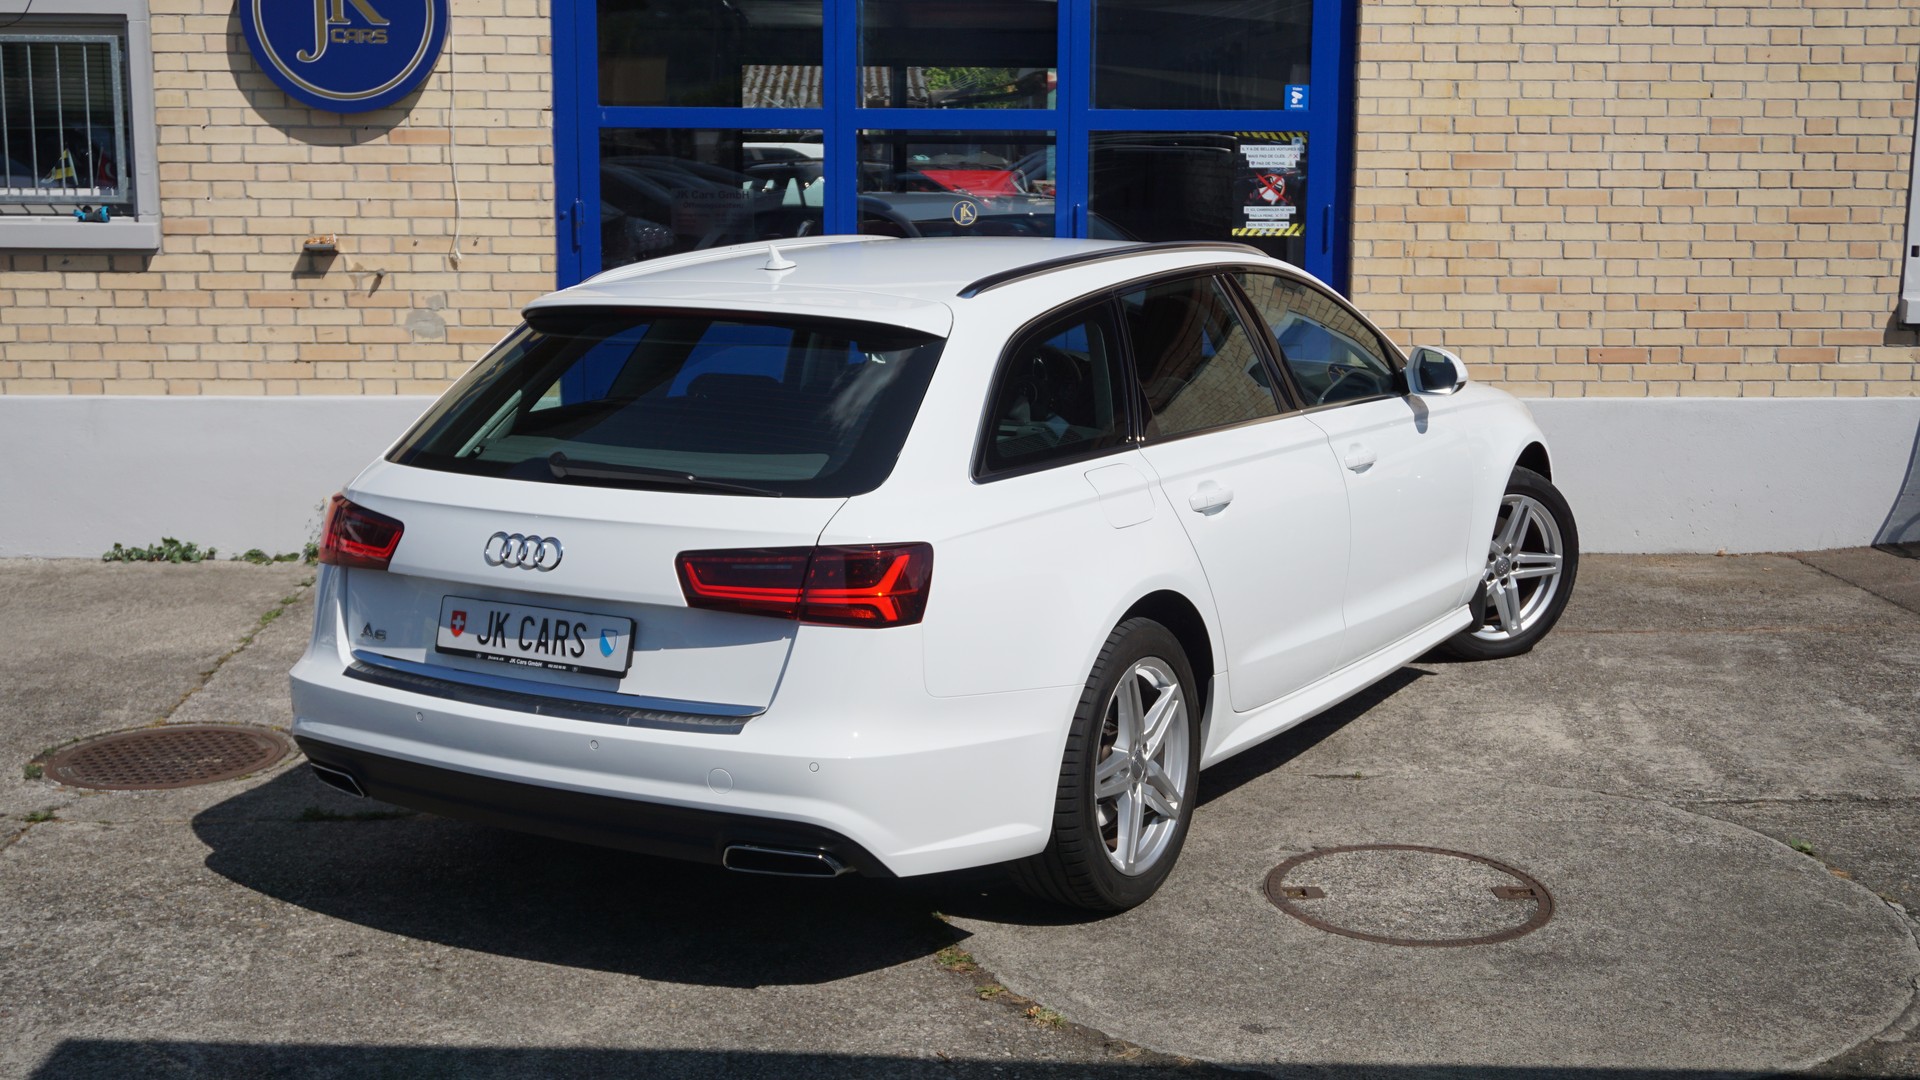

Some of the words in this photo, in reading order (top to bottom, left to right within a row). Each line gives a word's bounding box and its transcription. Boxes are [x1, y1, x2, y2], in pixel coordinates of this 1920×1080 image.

[330, 28, 388, 44] CARS
[675, 190, 688, 199] JK
[691, 190, 714, 199] Cars
[718, 190, 750, 199] GmbH
[360, 622, 386, 641] A6
[476, 610, 510, 648] JK
[518, 616, 587, 658] CARS
